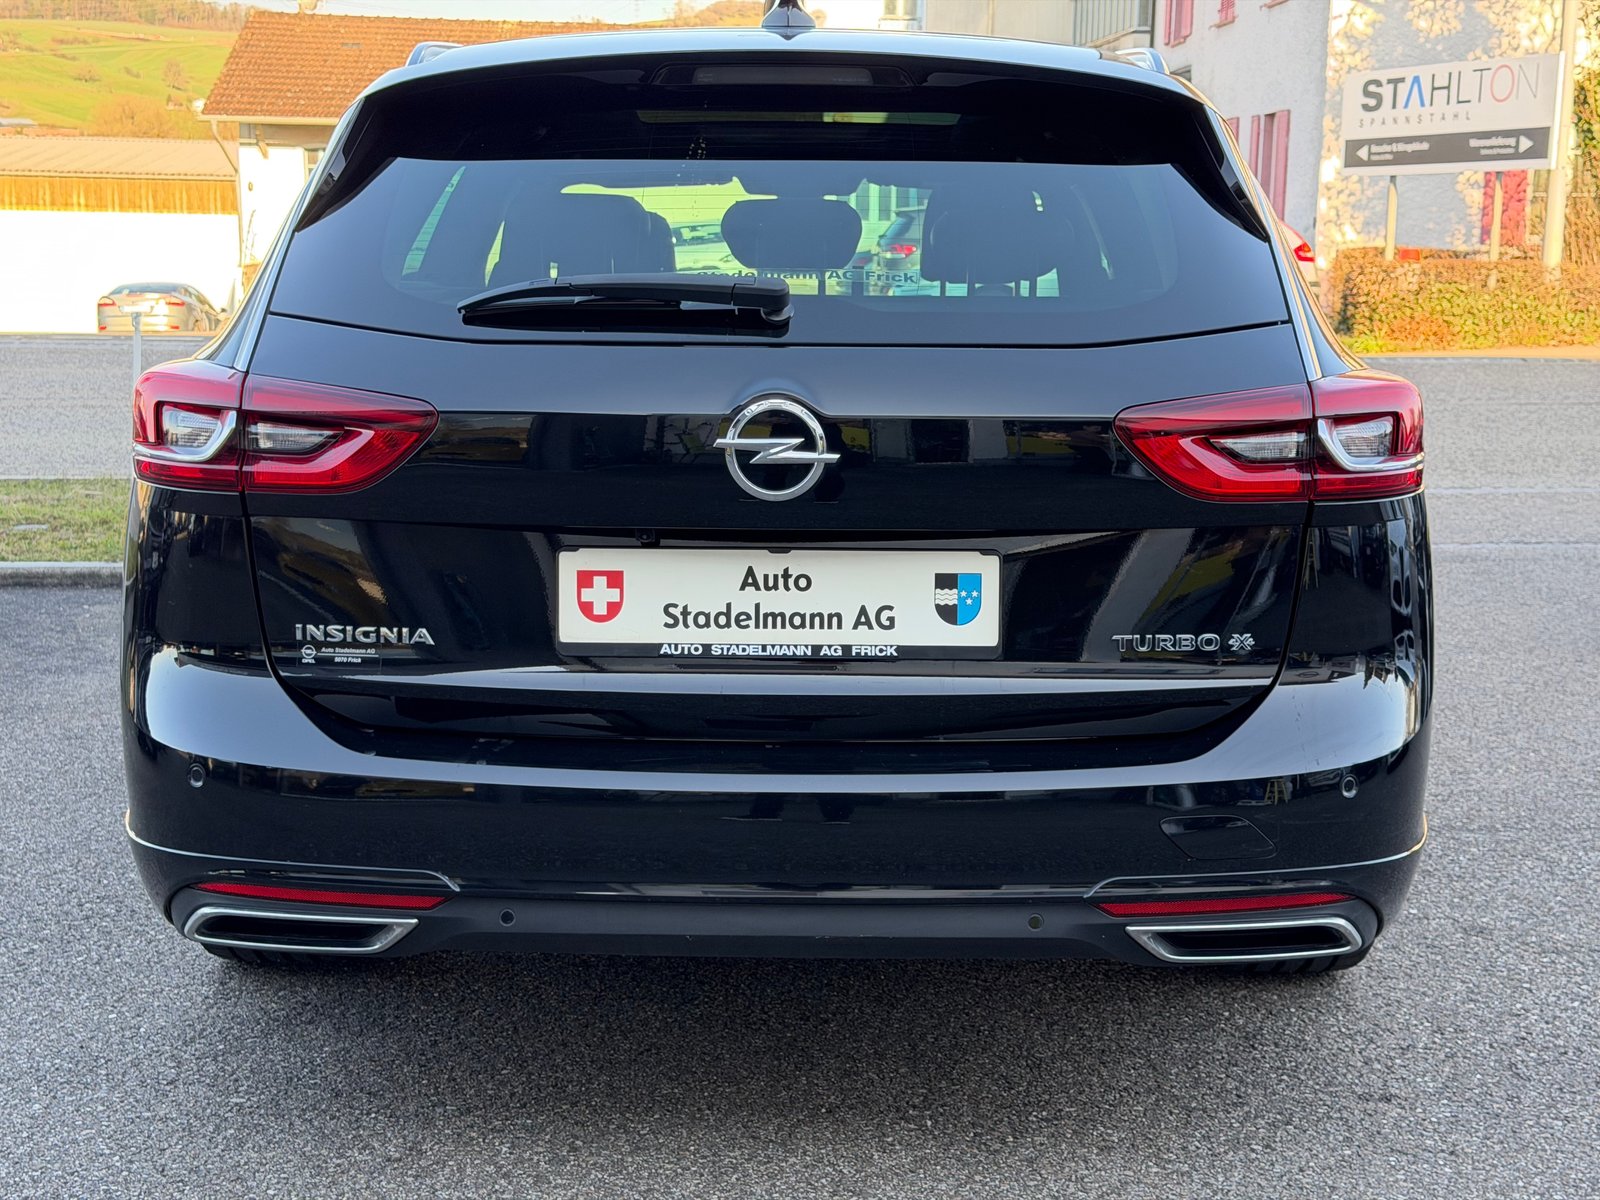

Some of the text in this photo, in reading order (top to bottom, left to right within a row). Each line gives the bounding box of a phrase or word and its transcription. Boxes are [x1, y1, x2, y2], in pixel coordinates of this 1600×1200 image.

[1361, 63, 1539, 112] STAHLTON
[1359, 112, 1471, 128] SPANNSTAHL
[865, 271, 917, 284] Frick
[739, 565, 812, 592] Auto
[663, 602, 896, 631] Stadelmann AG
[295, 623, 435, 646] INSIGNIA
[1112, 633, 1221, 652] TURBO
[660, 643, 898, 657] AUTO STADELMANN AG FRICK
